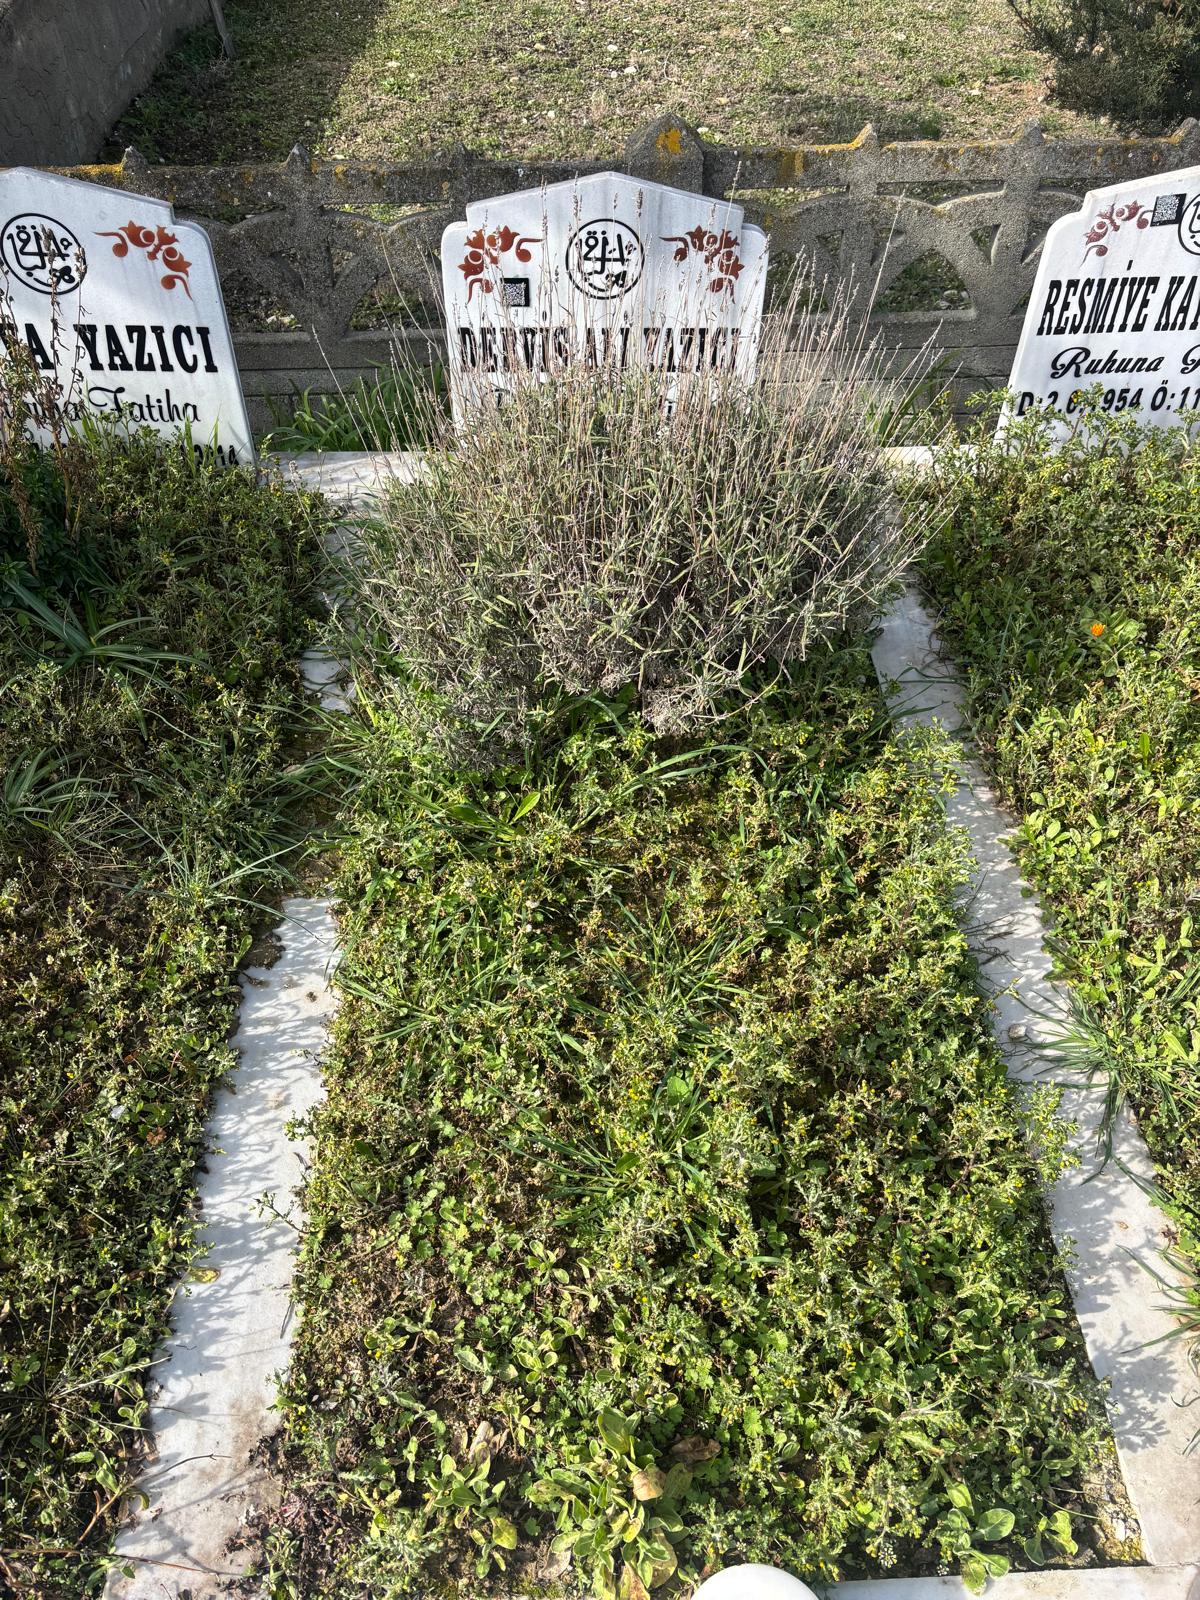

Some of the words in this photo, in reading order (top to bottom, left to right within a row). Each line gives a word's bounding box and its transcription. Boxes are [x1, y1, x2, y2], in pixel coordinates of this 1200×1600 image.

[1036, 260, 1160, 336] RESMİYE
[73, 323, 218, 373] YAZICI
[1050, 346, 1165, 379] Ruhuna
